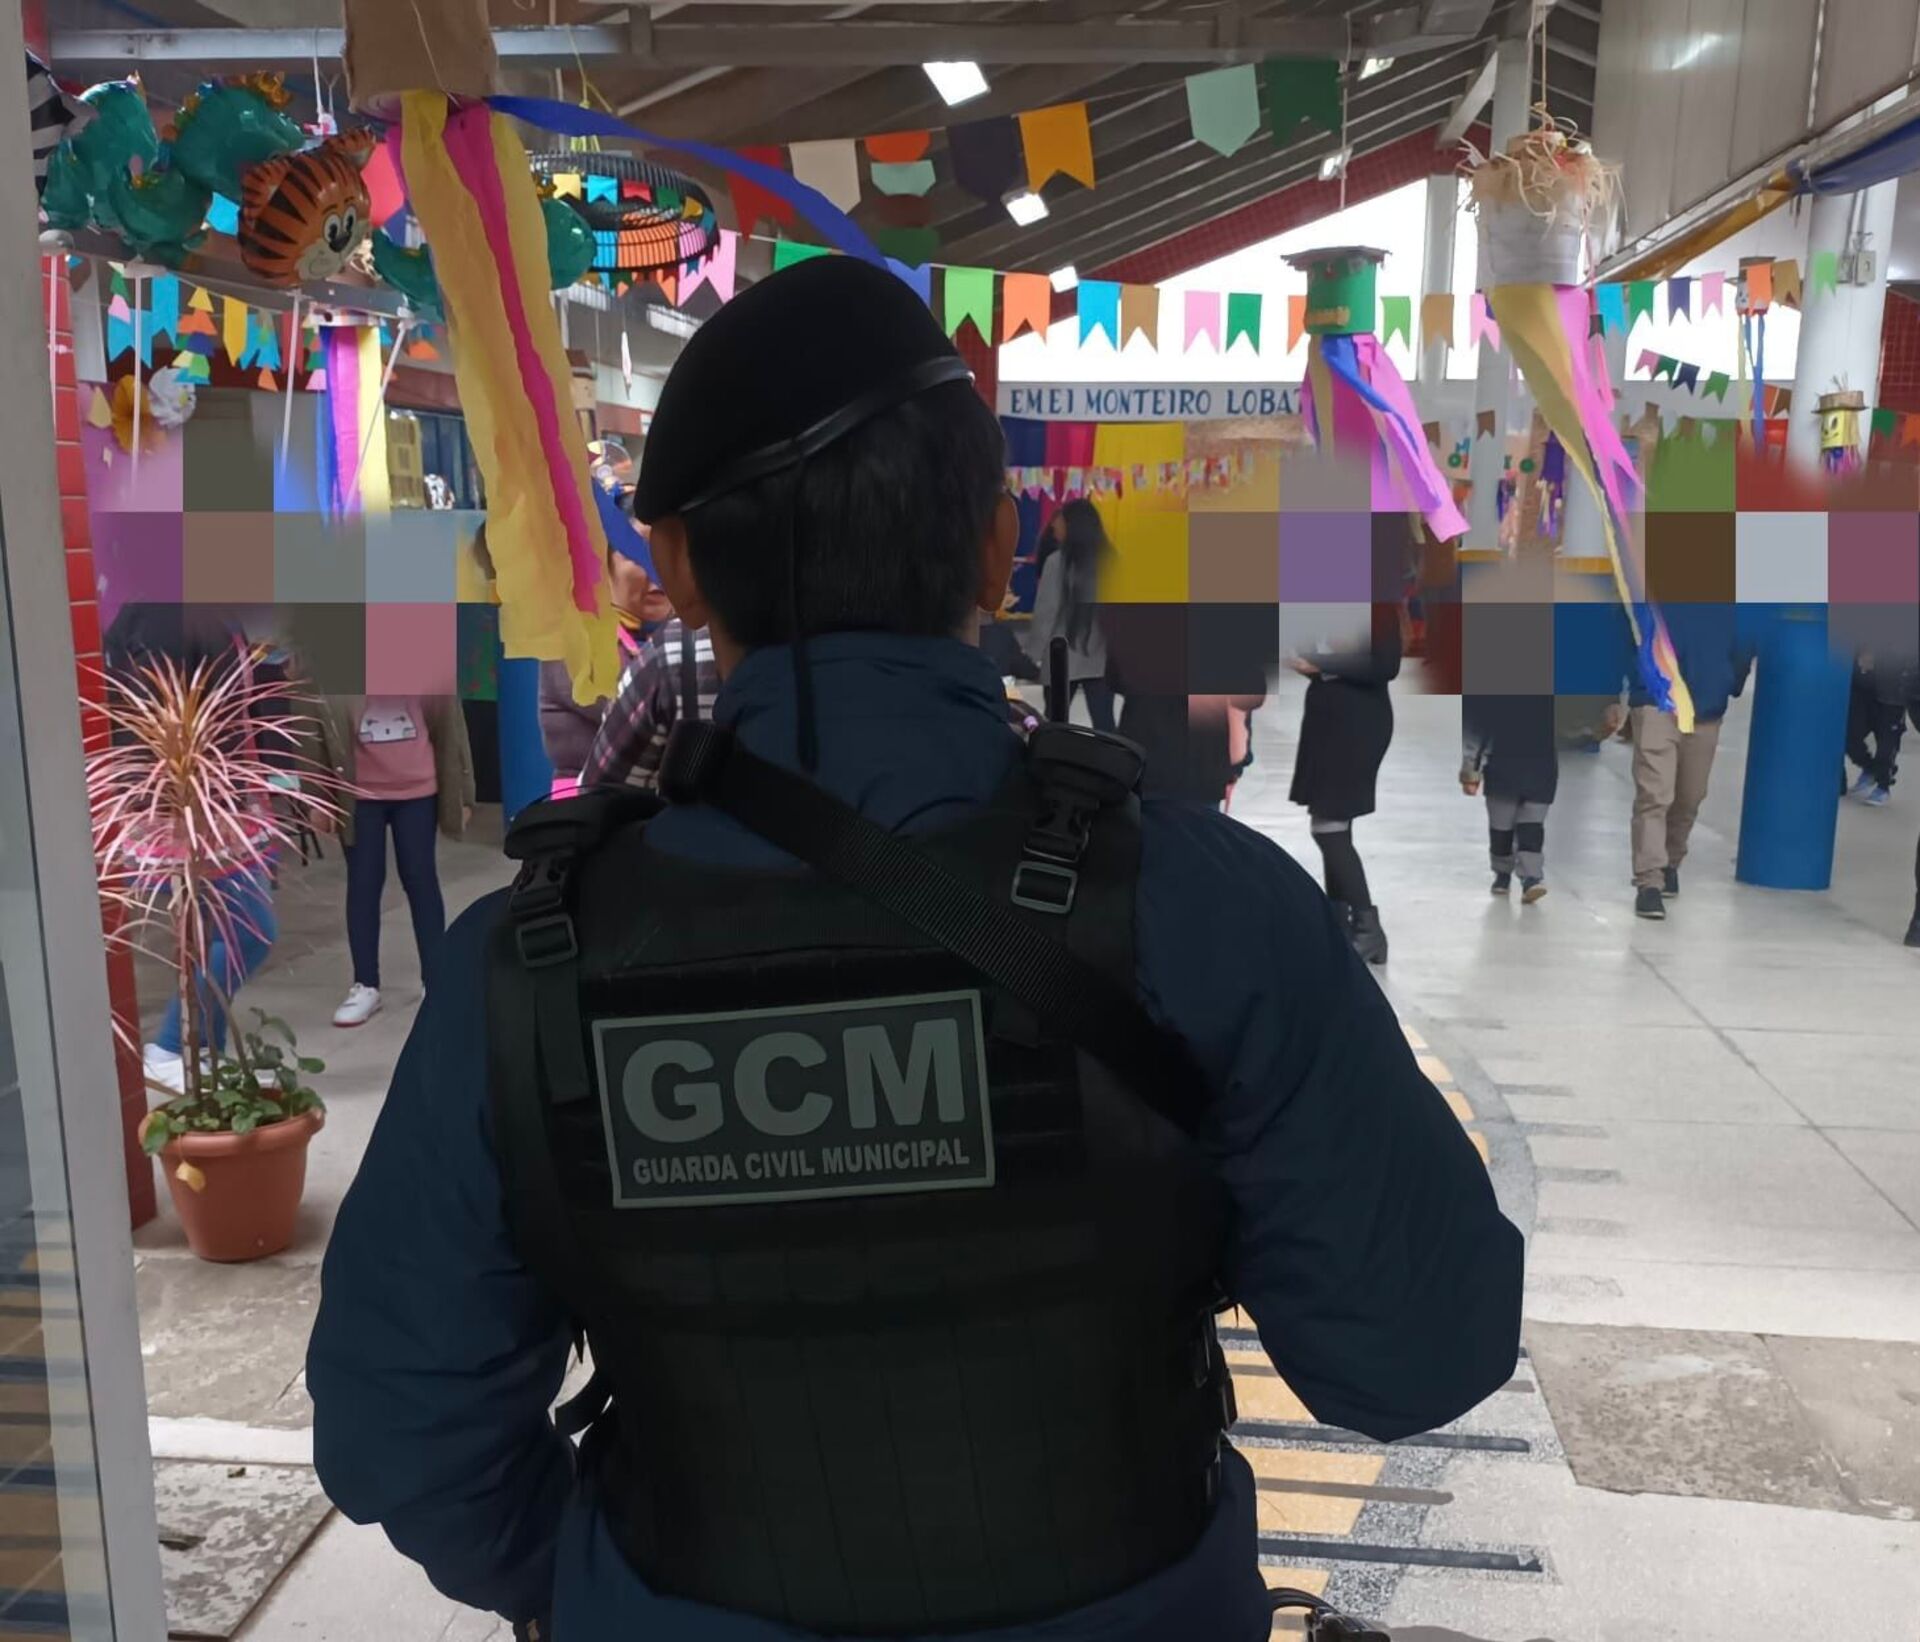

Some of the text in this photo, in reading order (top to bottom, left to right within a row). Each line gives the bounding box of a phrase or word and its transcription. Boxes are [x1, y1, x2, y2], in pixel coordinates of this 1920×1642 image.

[1010, 387, 1074, 415] EMEI
[1084, 387, 1212, 415] MONTEIRO
[622, 1018, 966, 1143] GCM
[632, 1138, 970, 1185] GUARDA CIVIL MUNICIPAL
